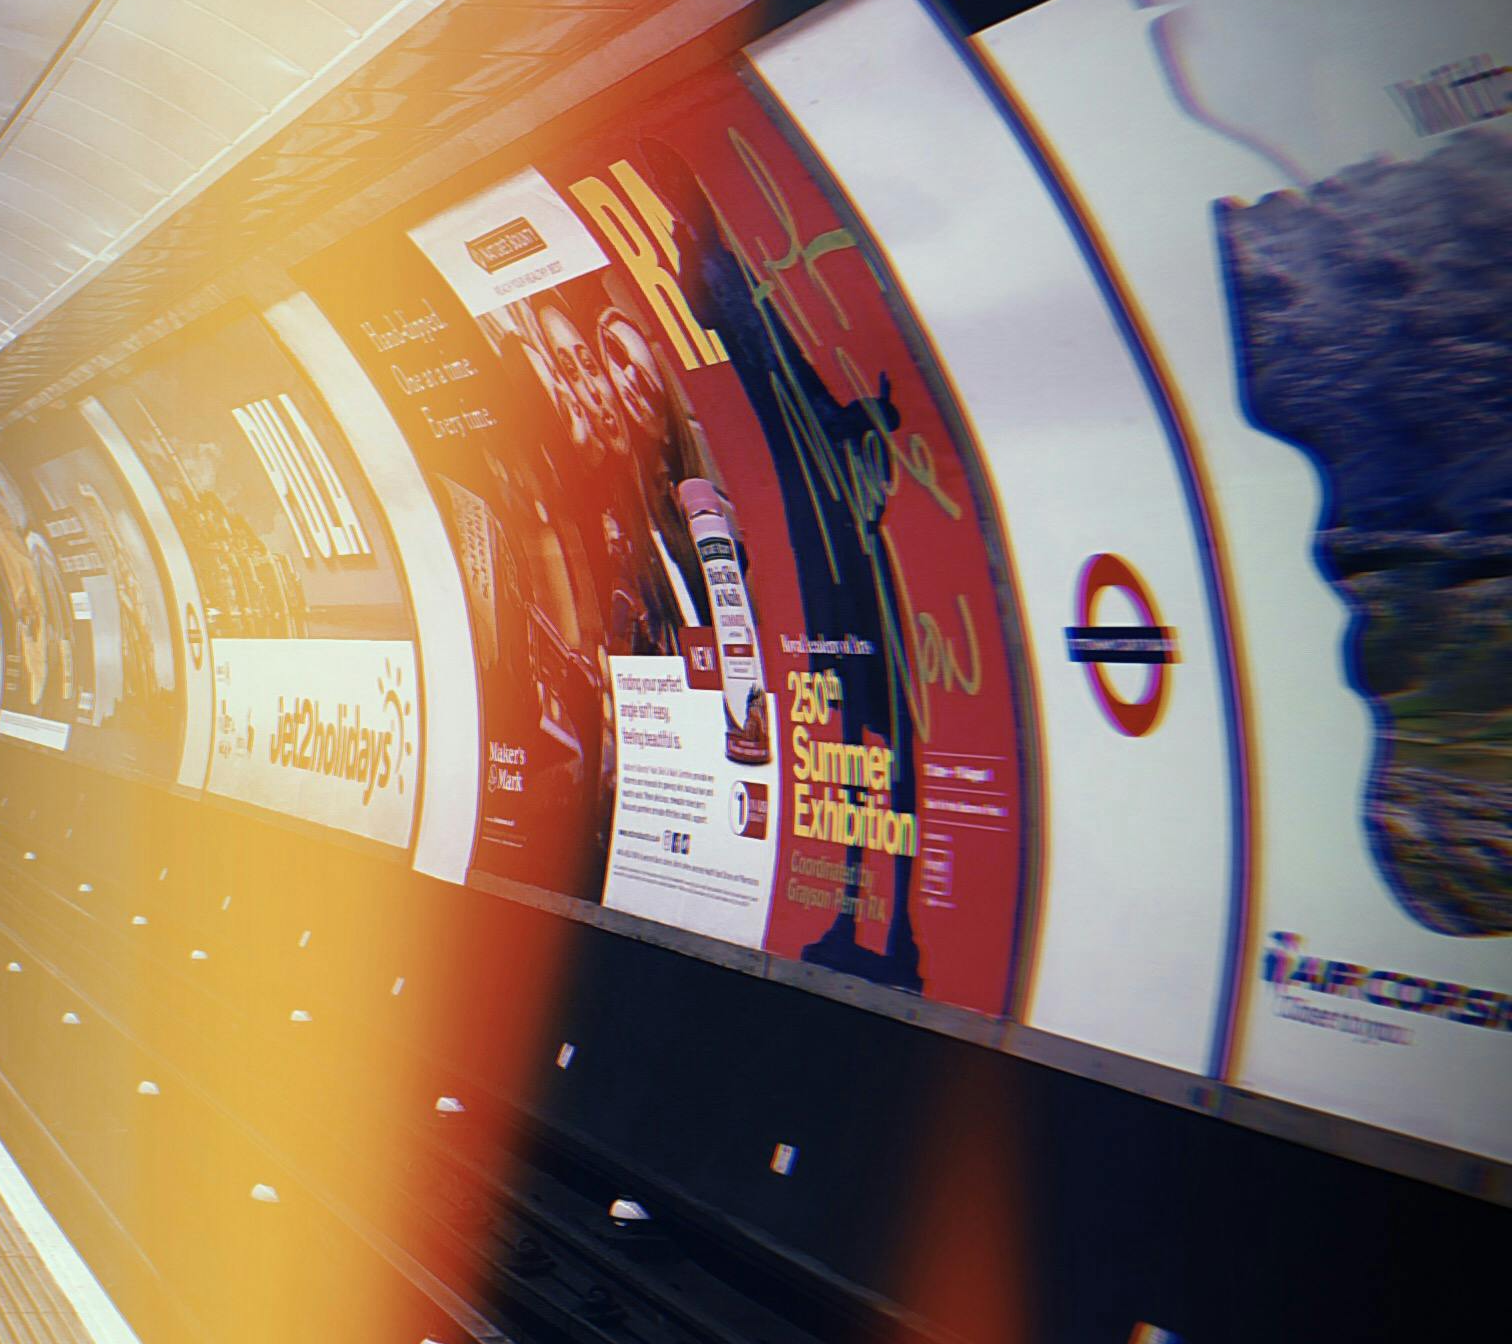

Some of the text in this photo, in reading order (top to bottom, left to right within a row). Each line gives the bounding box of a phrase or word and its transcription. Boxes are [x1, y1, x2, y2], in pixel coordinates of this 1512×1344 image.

[232, 393, 372, 558] PULA
[788, 668, 843, 727] 250th
[489, 741, 528, 766] Maker's
[792, 724, 895, 791] Summer
[497, 768, 524, 792] Mark
[793, 782, 919, 858] Exhibition
[791, 848, 857, 885] Coordinated
[787, 877, 834, 911] Grayson
[834, 886, 865, 920] Perry
